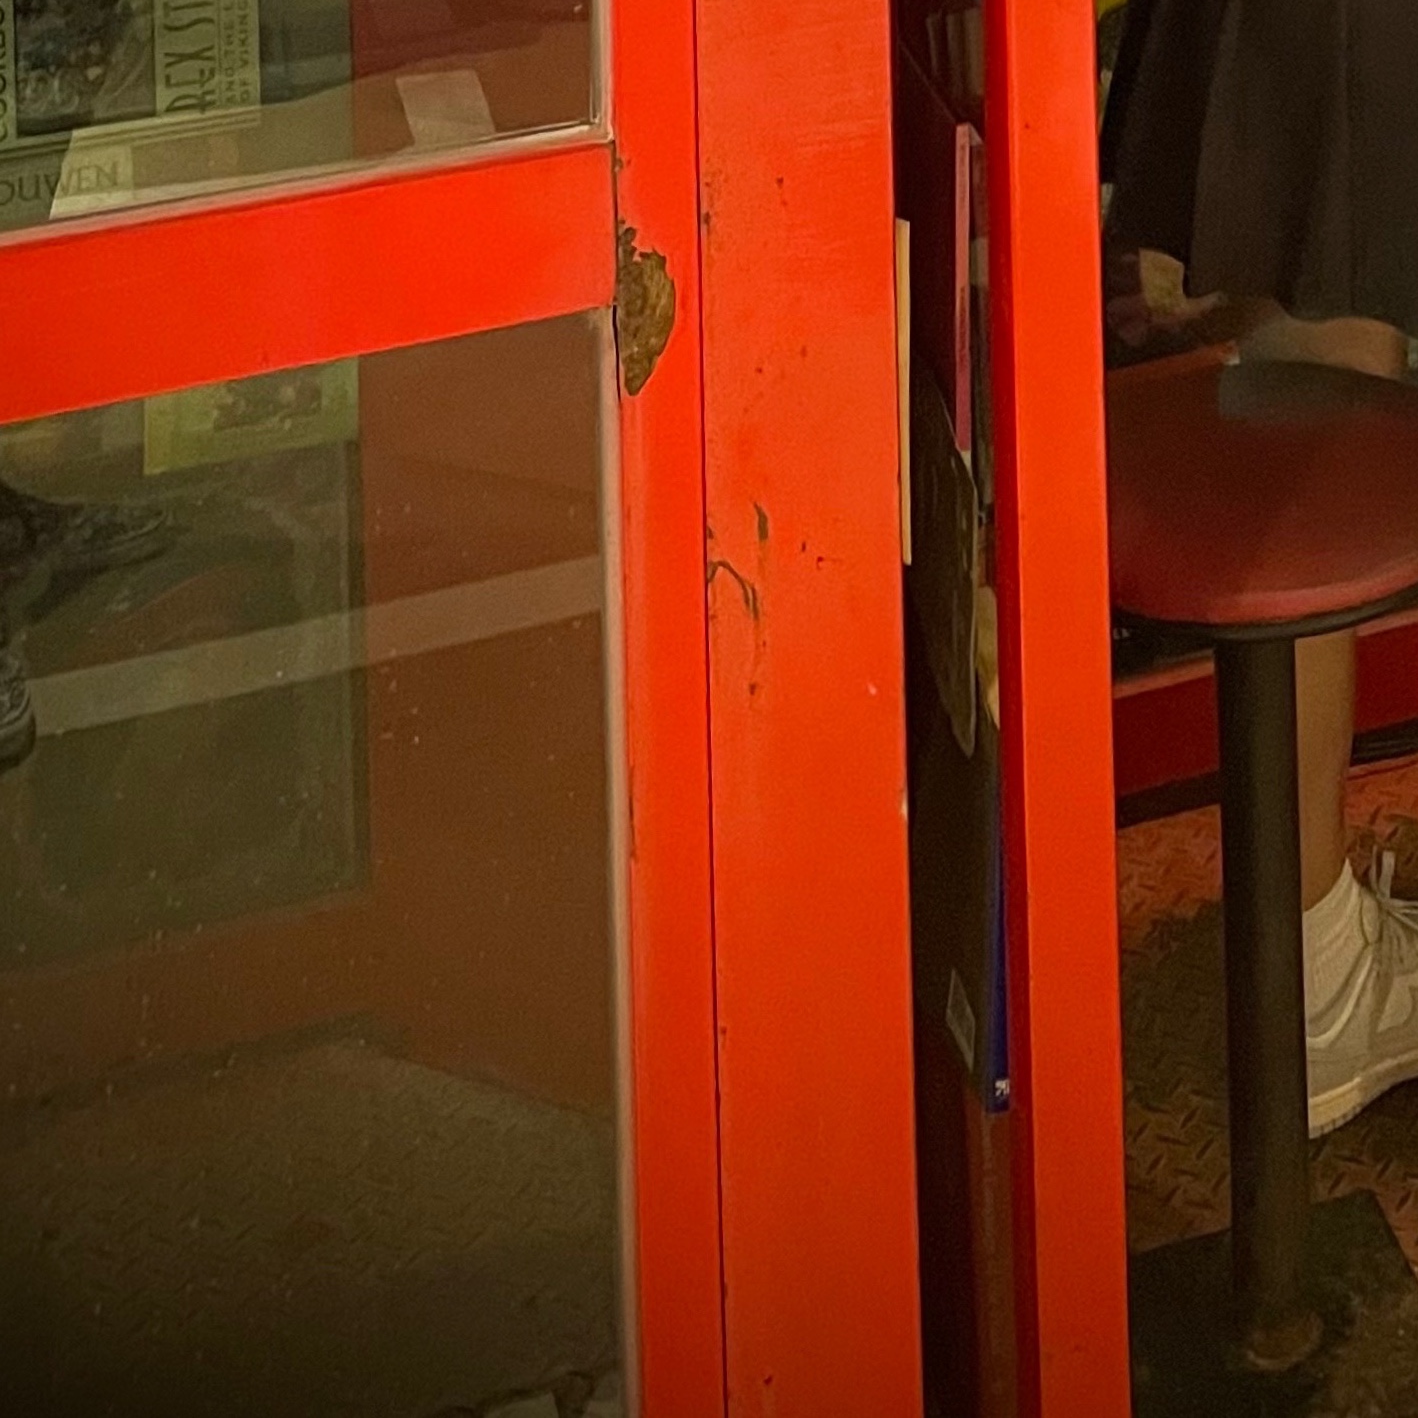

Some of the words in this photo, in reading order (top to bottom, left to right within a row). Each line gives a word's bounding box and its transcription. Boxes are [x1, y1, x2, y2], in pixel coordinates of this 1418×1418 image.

[223, 21, 234, 58] THE
[163, 44, 216, 114] REX
[224, 66, 236, 105] AND
[238, 79, 250, 105] OF
